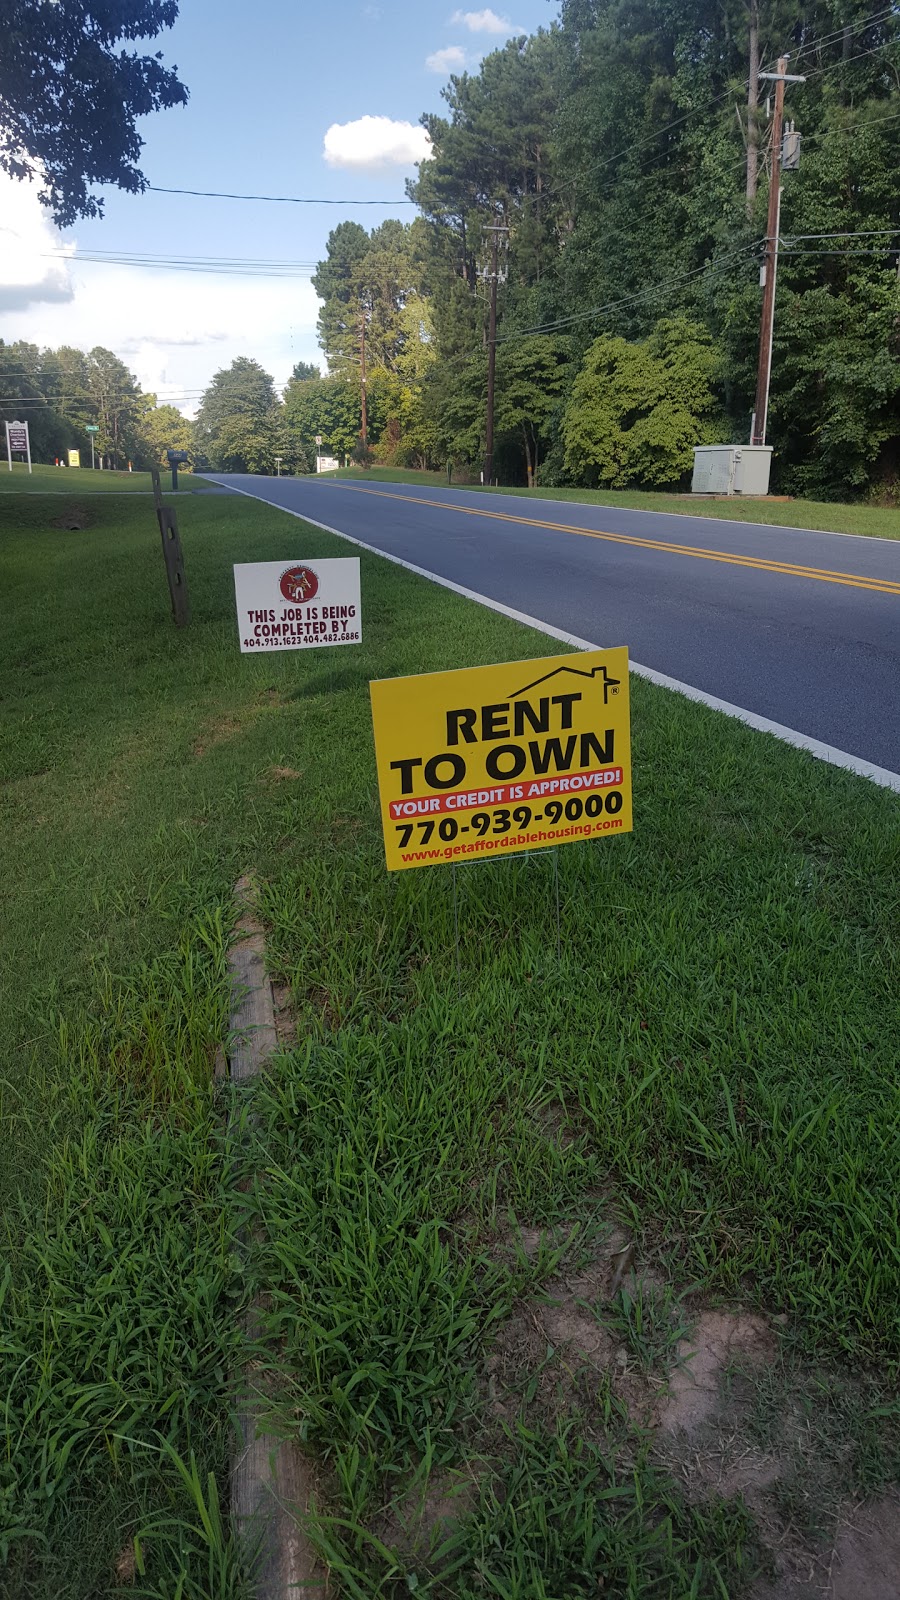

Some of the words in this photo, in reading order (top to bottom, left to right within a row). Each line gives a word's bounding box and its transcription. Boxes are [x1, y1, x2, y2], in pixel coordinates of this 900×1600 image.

[247, 610, 275, 623] THIS
[280, 608, 302, 622] JOB
[307, 607, 318, 620] IS
[322, 605, 356, 619] BEING
[254, 622, 327, 637] COMPLETED
[332, 620, 349, 633] BY
[243, 636, 301, 647] 404.913.1623
[303, 632, 360, 643] 404.482.6886
[446, 692, 582, 747] RENT
[390, 753, 467, 795] TO
[485, 729, 615, 781] OWN
[392, 798, 440, 817] YOUR
[445, 788, 505, 809] CREDIT
[509, 786, 523, 799] IS
[528, 769, 621, 796] APPROVED!
[395, 790, 623, 849] 770-939-9000
[401, 818, 623, 863] www.getaffordablehousing.com
